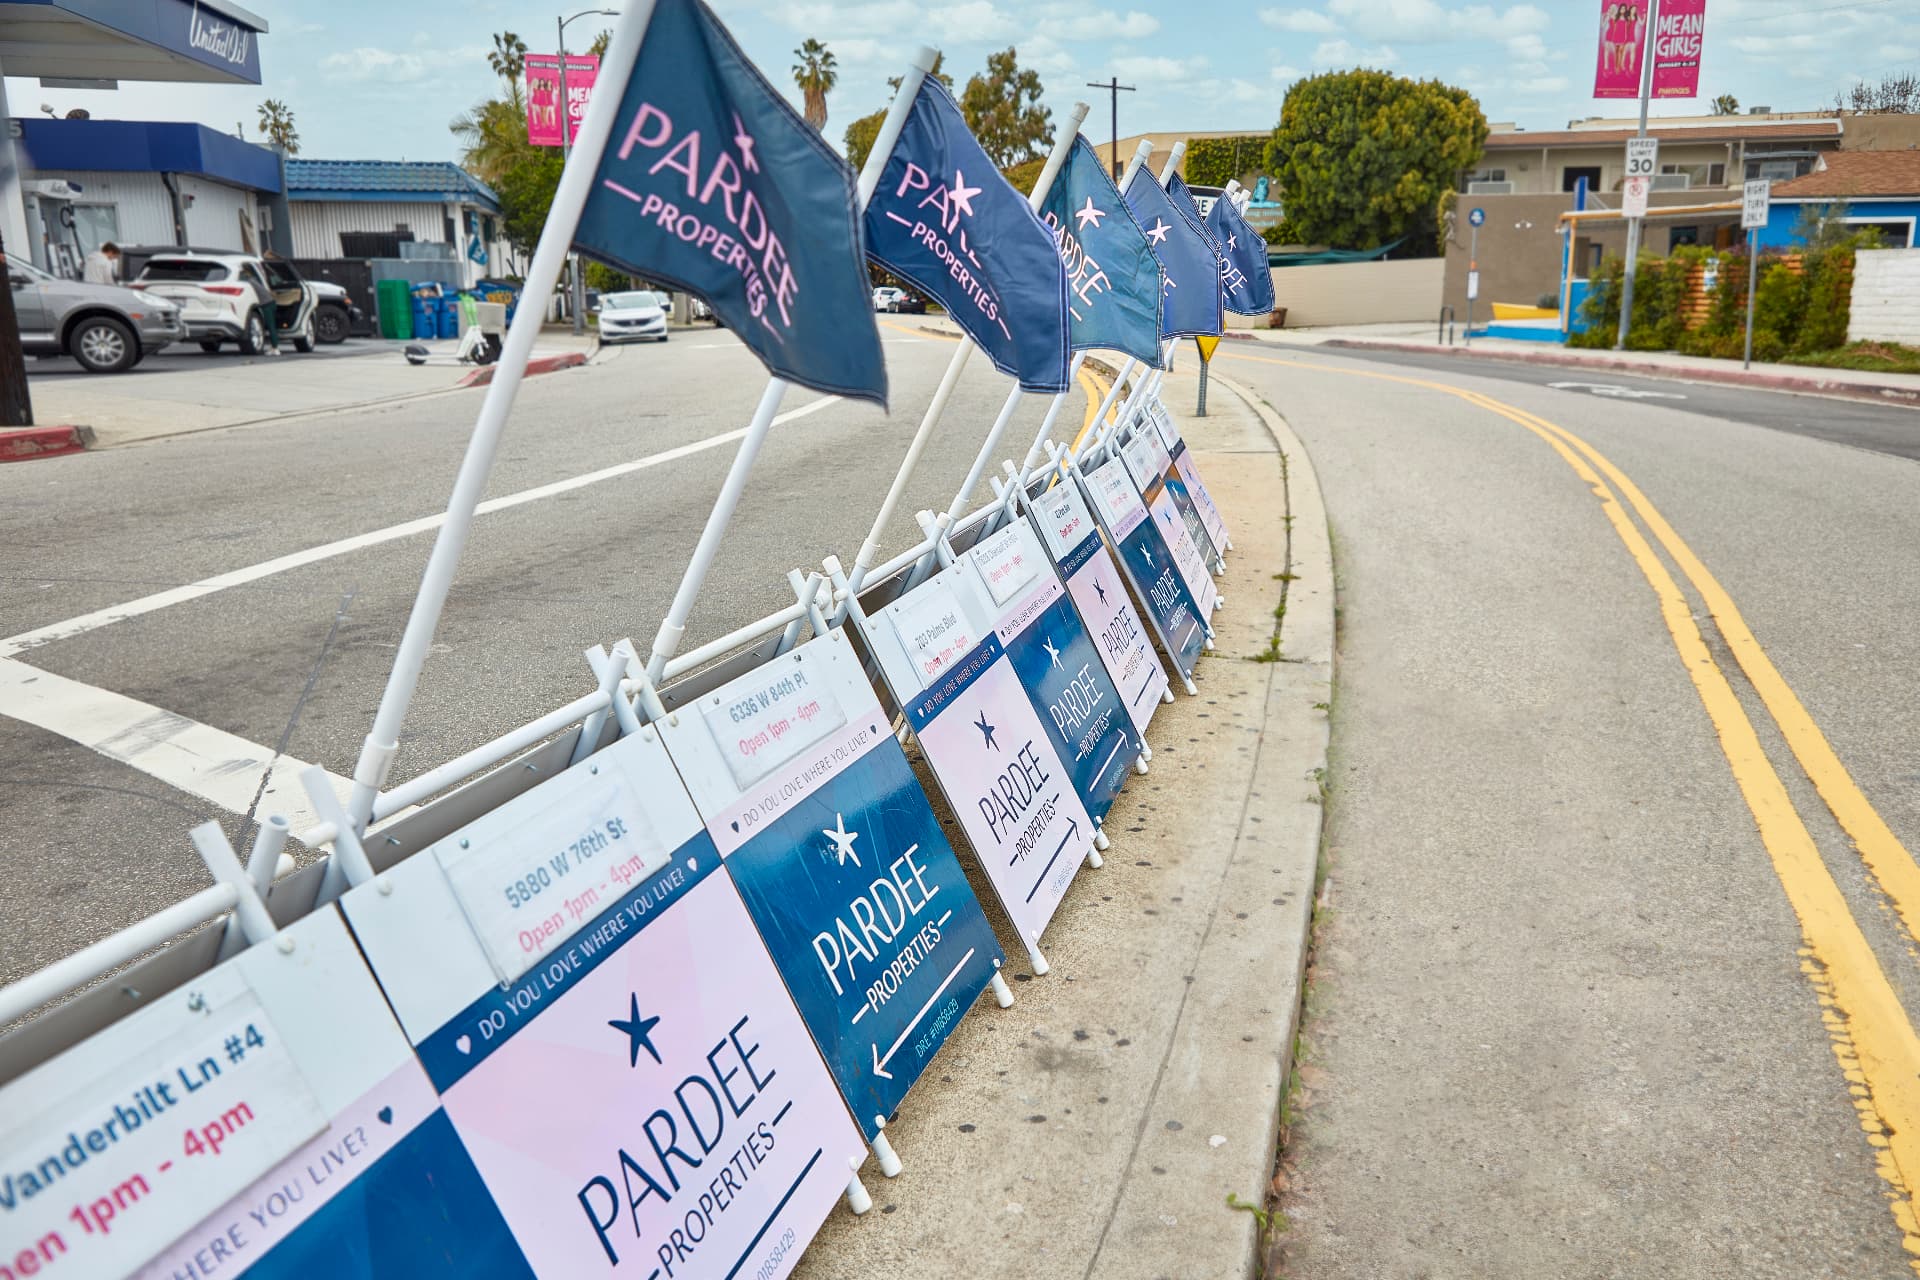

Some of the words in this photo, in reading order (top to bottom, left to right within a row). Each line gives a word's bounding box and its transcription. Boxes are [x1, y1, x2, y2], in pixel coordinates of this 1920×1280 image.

[190, 0, 231, 58] United
[227, 25, 249, 65] Oil
[1656, 36, 1700, 58] GIRLS
[1658, 14, 1704, 35] MEAN
[568, 87, 593, 103] MEA
[1629, 159, 1653, 173] 30
[617, 103, 798, 328] PARDEE
[641, 194, 769, 318] PROPERTIES
[911, 221, 999, 320] PROPERTIES
[729, 698, 759, 724] 6336
[756, 690, 771, 709] W
[770, 677, 795, 701] 84th
[796, 671, 808, 689] Pl
[738, 732, 769, 757] Open
[768, 718, 790, 740] 1pm
[797, 700, 821, 722] 4pm
[1050, 663, 1103, 743] PARDEE
[743, 808, 759, 827] DO
[757, 795, 780, 816] YOU
[779, 776, 803, 801] LOVE
[801, 756, 832, 784] WHERE
[830, 744, 849, 765] YOU
[848, 732, 869, 753] LIVE?
[978, 740, 1049, 845] PARDEE
[504, 866, 551, 909] 5880
[550, 854, 570, 877] W
[569, 831, 608, 868] 76th
[606, 816, 628, 840] St
[1015, 798, 1058, 862] PROPERTIES
[518, 912, 565, 954] Open
[564, 887, 599, 923] 1pm
[609, 854, 645, 887] 4pm
[811, 843, 940, 996] PARDEE
[478, 1010, 506, 1040] DO
[505, 982, 541, 1017] YOU
[541, 951, 582, 990] LOVE
[579, 914, 628, 957] WHERE
[626, 892, 654, 924] YOU
[653, 868, 686, 900] LIVE?
[865, 920, 942, 1014] PROPERTIES
[915, 1034, 932, 1058] DRE
[0, 1081, 179, 1210] Vanderbilt
[177, 1053, 222, 1094] Ln
[224, 1023, 266, 1064] #4
[577, 1015, 776, 1266] PARDEE
[69, 1172, 151, 1235] 1pm
[183, 1102, 255, 1158] 4pm
[170, 1222, 249, 1280] HERE
[248, 1181, 304, 1229] YOU
[311, 1127, 369, 1187] LIVE?
[657, 1122, 776, 1279] PROPERTIES
